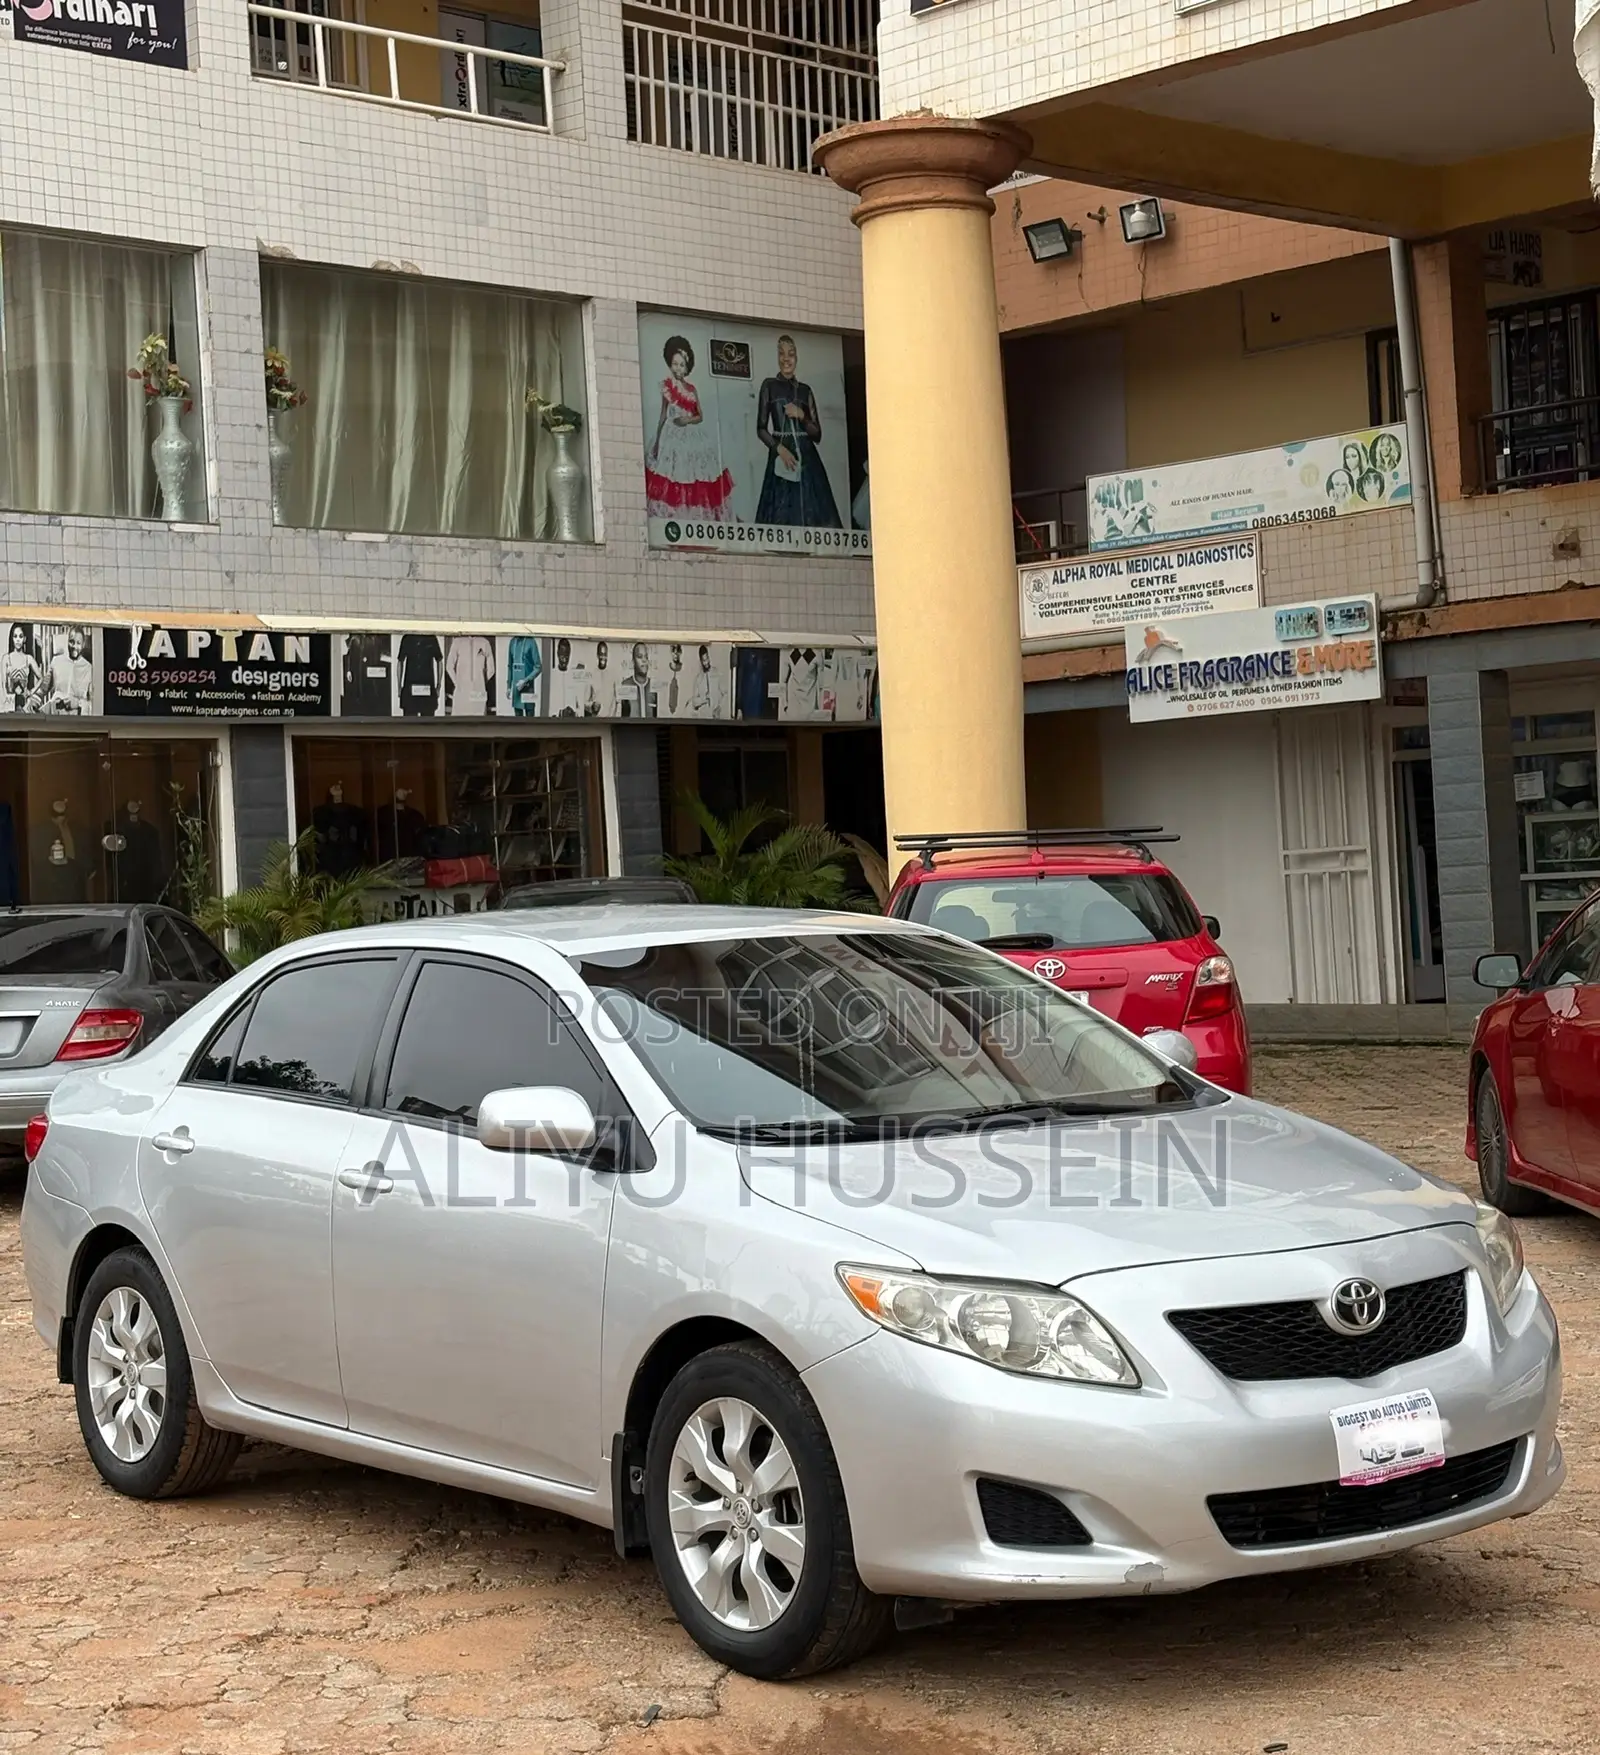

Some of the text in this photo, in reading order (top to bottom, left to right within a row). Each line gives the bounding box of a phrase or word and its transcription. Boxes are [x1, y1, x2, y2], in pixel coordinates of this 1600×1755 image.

[91, 41, 112, 51] extra
[127, 32, 178, 53] for you!
[1508, 229, 1542, 258] HAIRS
[1182, 496, 1202, 505] KINDS
[1202, 494, 1211, 502] OF
[1211, 491, 1235, 501] HUMAN
[1252, 505, 1336, 529] 08063453068
[685, 523, 800, 548] 08065267681,
[1052, 542, 1255, 585] ALPHA ROYAL MEDICAL DIAGNOSTICS
[1130, 573, 1177, 588] CENTRE
[1038, 579, 1225, 610] COMPREHENSIVE LABORATORY SERVICES
[1038, 605, 1091, 619] VOLUNTARY
[1092, 598, 1152, 612] COUNSELING
[1154, 597, 1161, 605] &
[1163, 590, 1204, 604] TESTING
[1206, 584, 1254, 598] SERVICES
[231, 665, 319, 691] designers
[1126, 640, 1374, 694] ALICE FRAGRANCE & MORE
[116, 686, 322, 704] Tailoring Fabric Accessories Fashion Academy
[1208, 691, 1217, 699] OF
[1218, 690, 1229, 698] OIL
[1231, 686, 1265, 696] PERFUMES
[1271, 683, 1293, 692] OTHER
[1293, 679, 1322, 690] FASHION
[1323, 677, 1343, 687] ITEMS
[1197, 703, 1218, 712] 0706
[1220, 701, 1234, 709] 627
[1336, 1396, 1432, 1428] BIGGEST MO AUTOS LIMITED
